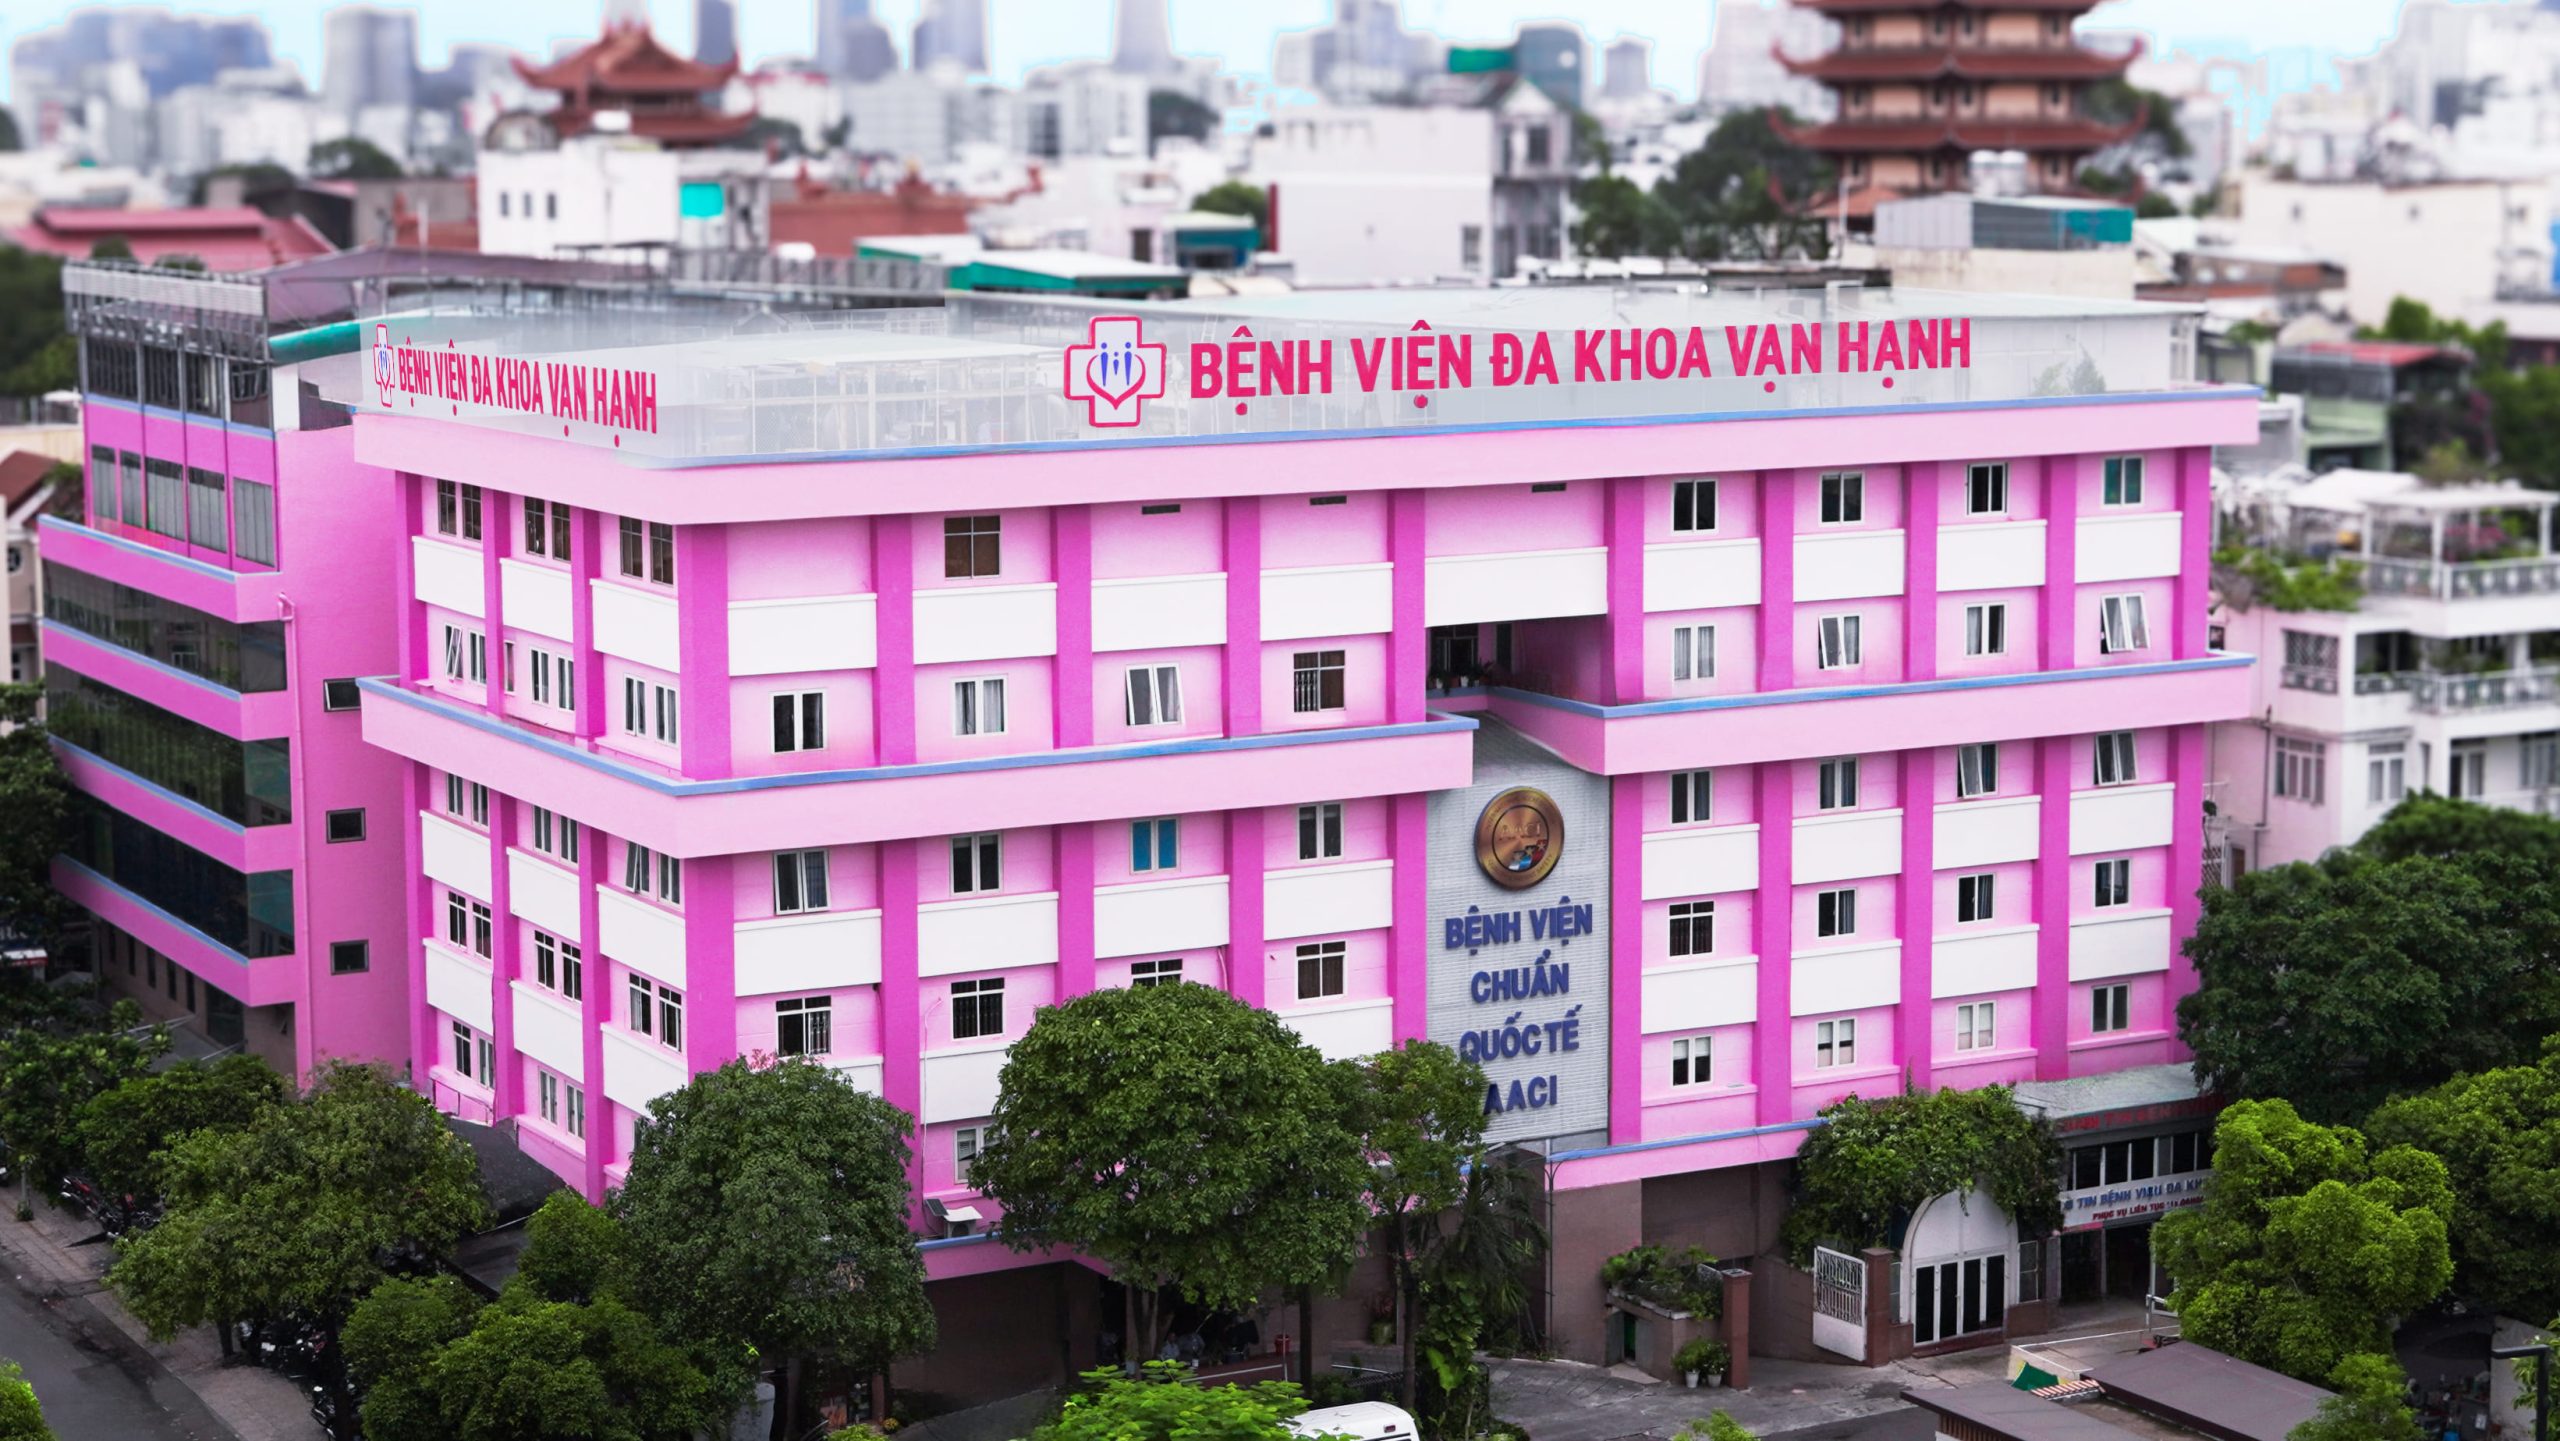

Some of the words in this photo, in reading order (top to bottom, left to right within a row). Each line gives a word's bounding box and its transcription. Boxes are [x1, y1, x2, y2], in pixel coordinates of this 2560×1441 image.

[397, 336, 433, 408] BỆNH
[433, 338, 469, 416] VIỆN
[471, 354, 494, 407] ĐA
[495, 356, 544, 414] KHOA
[547, 362, 588, 437] VẠN
[593, 366, 658, 448] HẠNH
[1190, 325, 1333, 417] BỆNH
[1350, 319, 1472, 409] VIỆN
[1489, 331, 1559, 386] ĐA
[1574, 326, 1712, 382] KHOA
[1725, 322, 1822, 394] VẠN
[1838, 317, 1971, 389] HẠNH
[1445, 905, 1521, 956] BỆNH
[1529, 895, 1593, 946] VIỆN
[1470, 949, 1570, 1004] CHUẨN
[1459, 1011, 1542, 1064] QUỐC
[1544, 1004, 1583, 1053] TẾ
[1483, 1074, 1558, 1115] AACI
